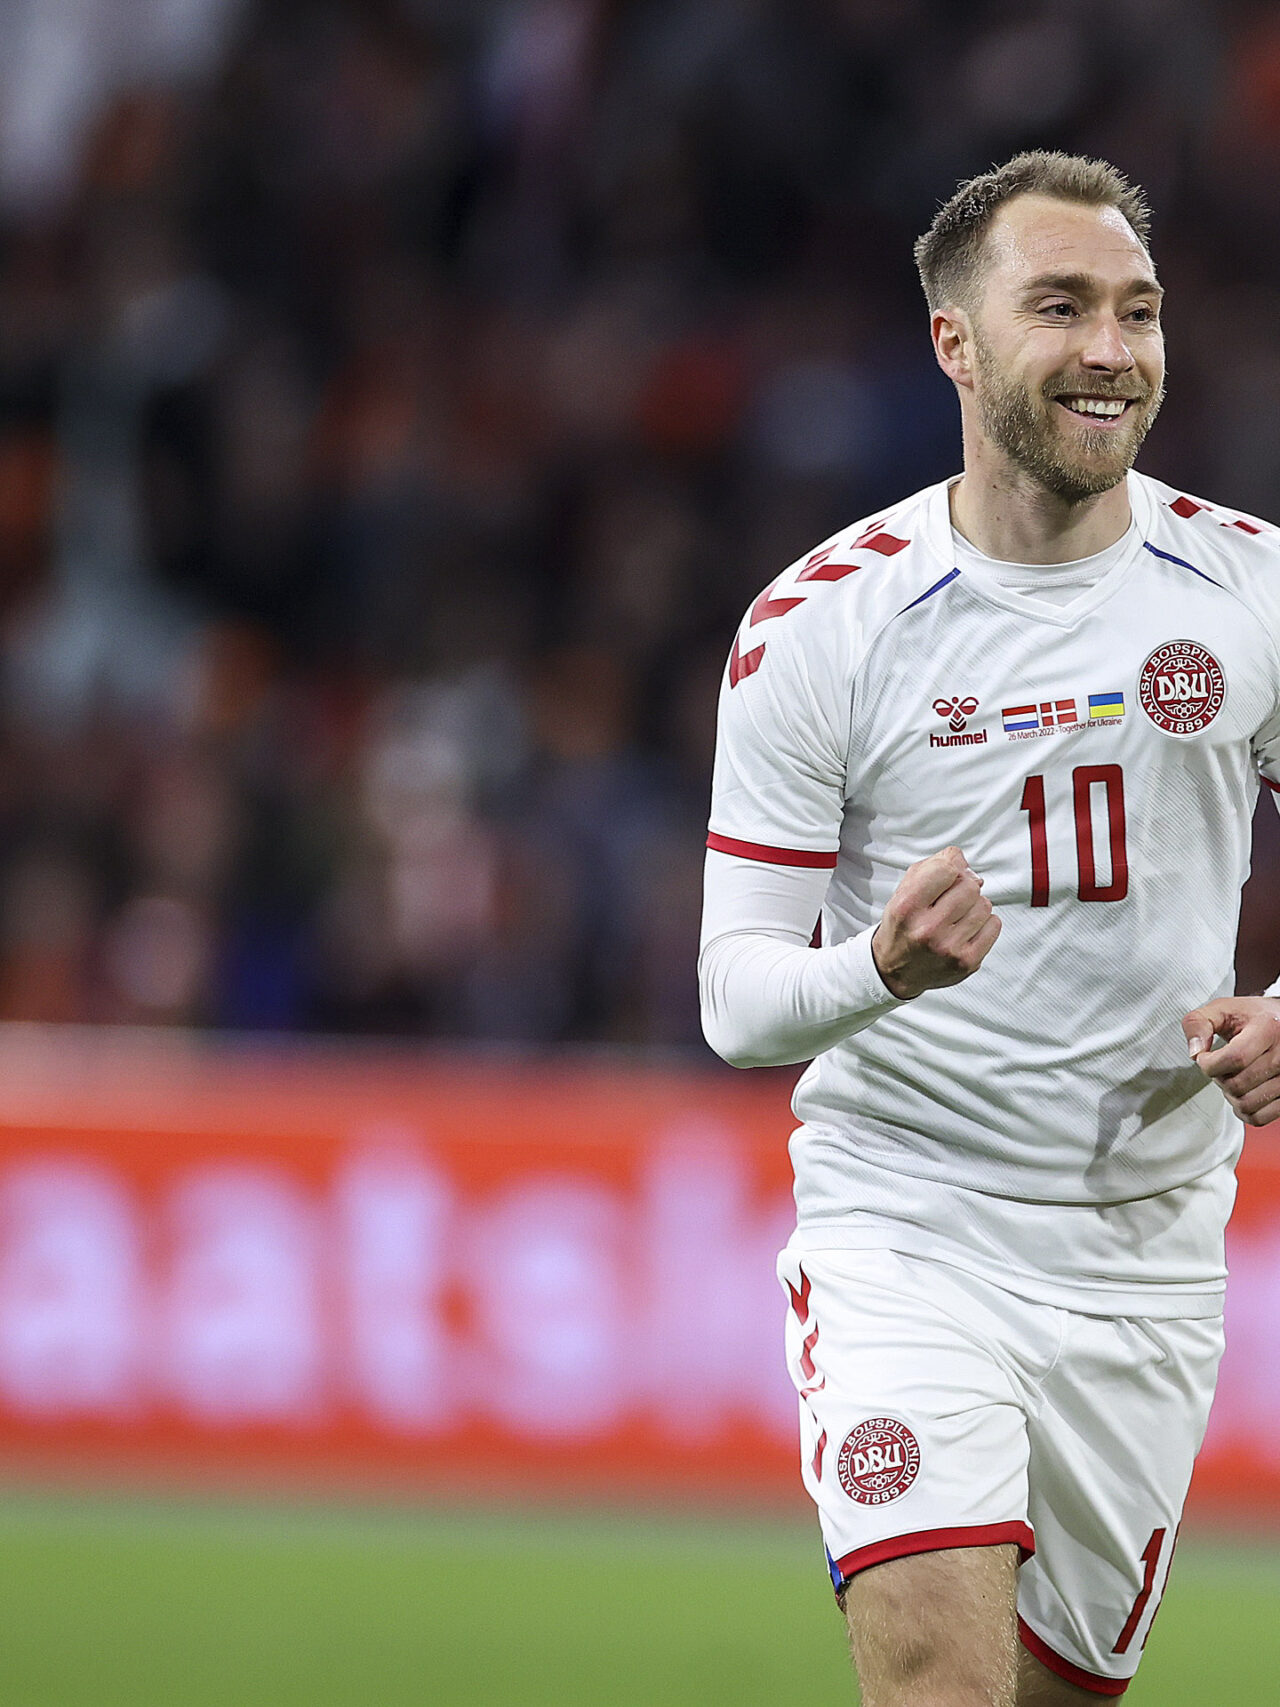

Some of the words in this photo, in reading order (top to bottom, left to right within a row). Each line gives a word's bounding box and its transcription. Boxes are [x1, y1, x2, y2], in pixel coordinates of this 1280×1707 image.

[1141, 670, 1165, 725] DANSK
[1168, 718, 1204, 733] 1889
[1156, 672, 1208, 701] DBU
[930, 729, 988, 748] hummel
[1008, 732, 1017, 741] 26
[1017, 729, 1038, 740] March
[1039, 727, 1055, 737] 2022
[1059, 720, 1087, 735] Together
[1087, 718, 1097, 728] for
[1097, 717, 1123, 728] Ukraine
[1020, 763, 1129, 908] 10
[838, 1450, 862, 1500] DANSK
[864, 1486, 900, 1505] 1889
[852, 1442, 904, 1478] DBU
[1110, 1521, 1181, 1655] 1
